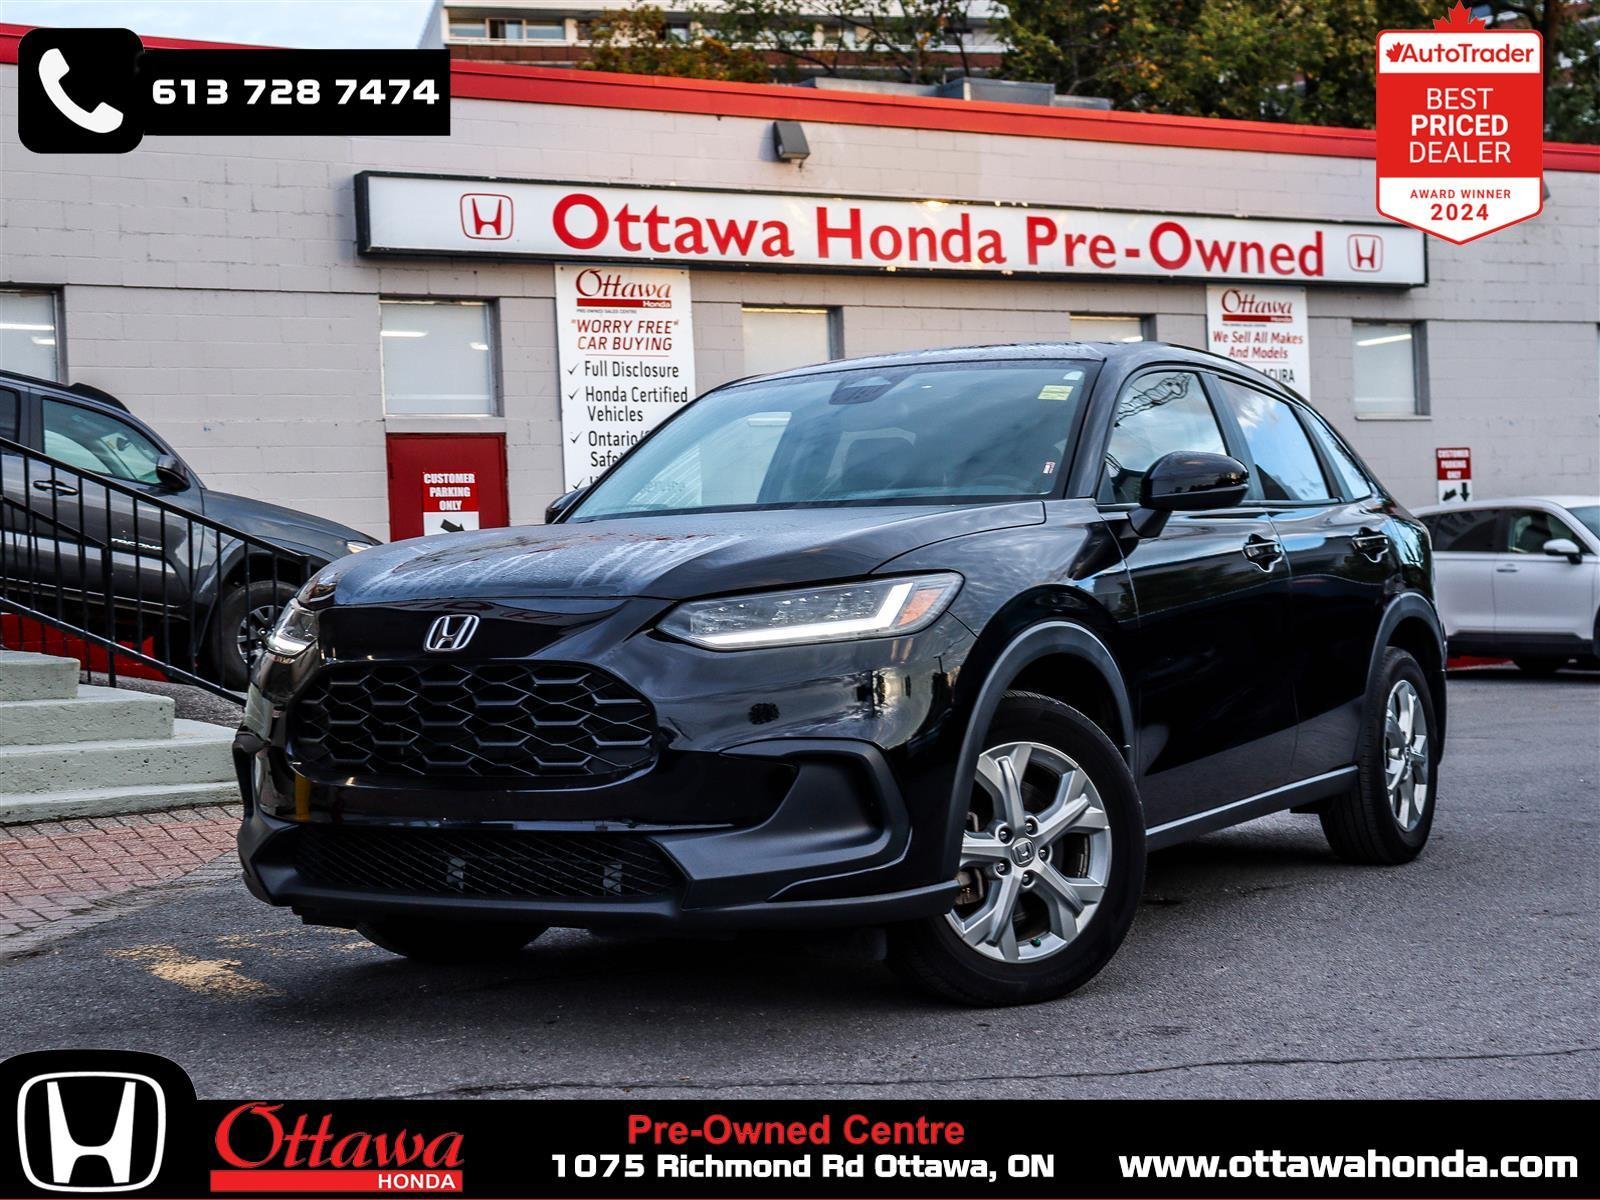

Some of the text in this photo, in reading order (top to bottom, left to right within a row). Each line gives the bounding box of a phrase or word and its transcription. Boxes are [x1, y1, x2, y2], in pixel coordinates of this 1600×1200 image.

[552, 193, 1325, 276] Ottawa Honda Pre-Owned
[575, 268, 673, 298] Ottawa
[1221, 288, 1294, 314] Ottawa
[577, 336, 673, 352] CAR BUYING
[1213, 330, 1305, 345] We Sell All Makes
[1228, 346, 1289, 360] And Models
[584, 360, 680, 379] Full Disclosure
[585, 386, 689, 404] Honda Certified
[587, 405, 644, 423] Vehicles
[423, 473, 476, 484] CUSTOMER
[429, 486, 471, 498] PARKING
[439, 500, 463, 511] ONLY
